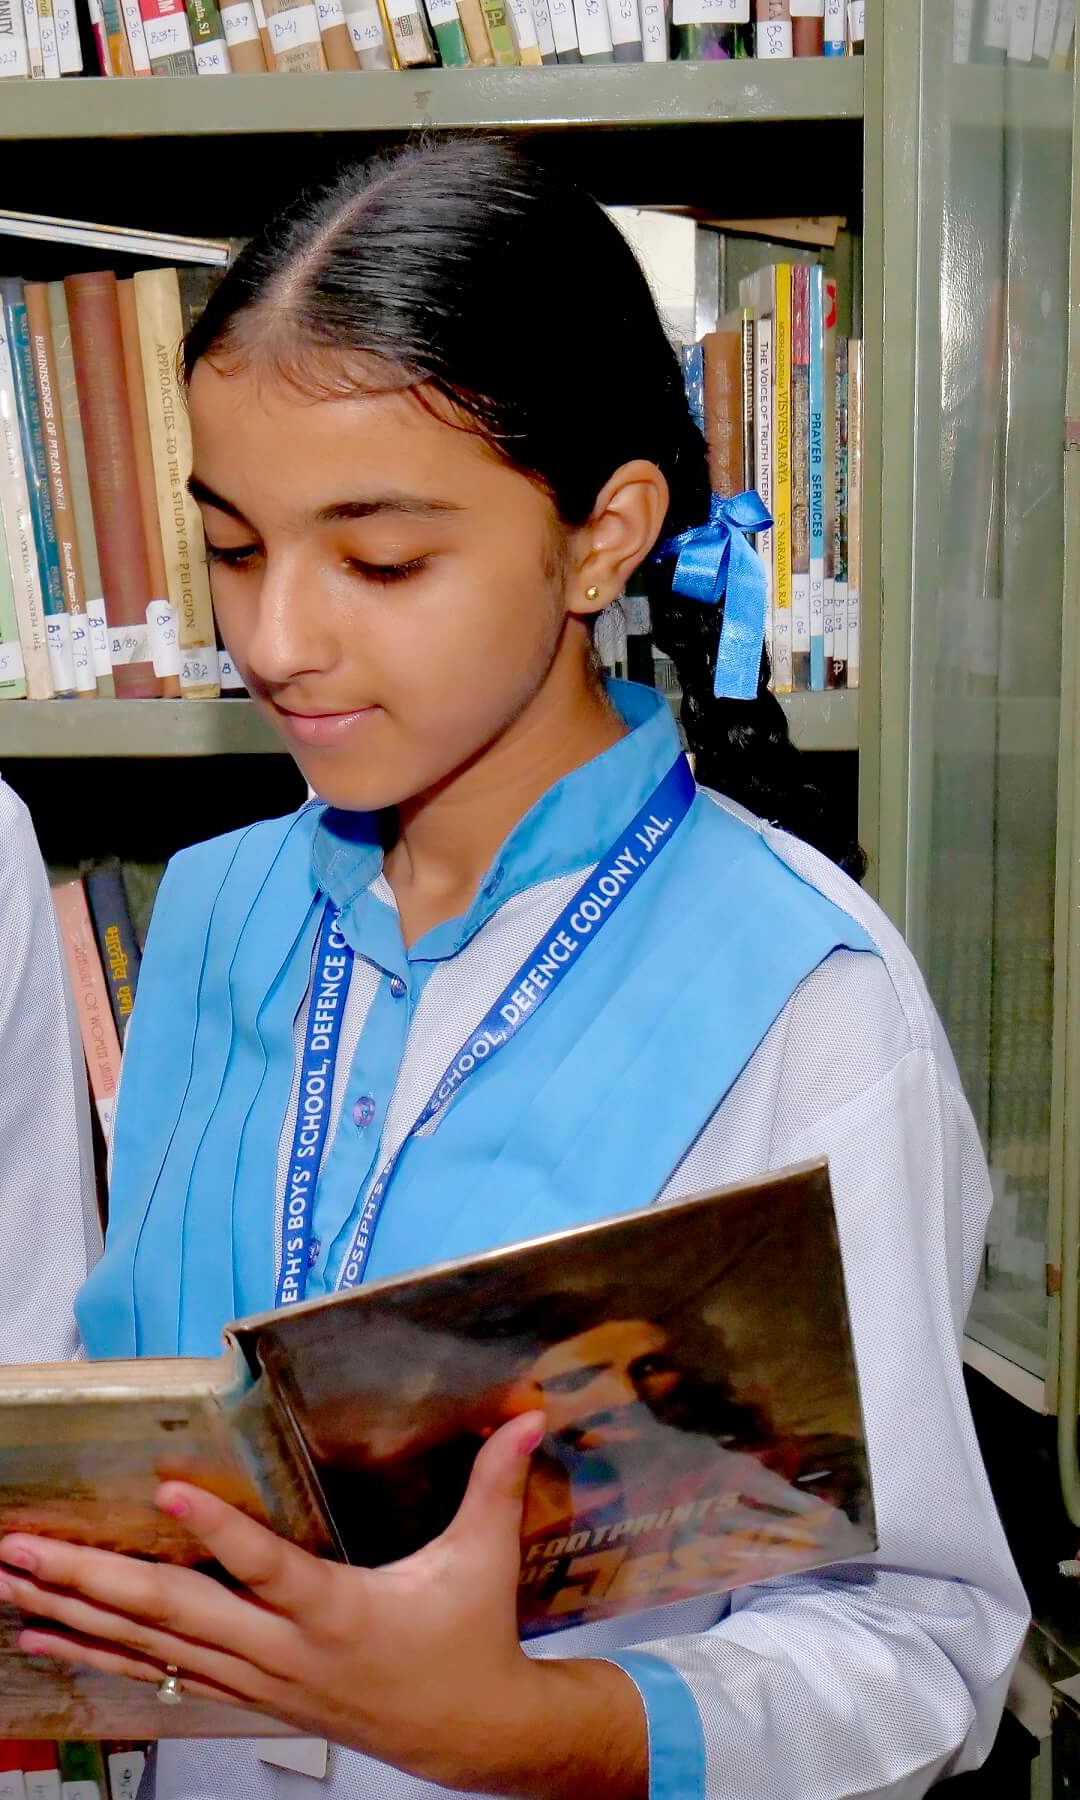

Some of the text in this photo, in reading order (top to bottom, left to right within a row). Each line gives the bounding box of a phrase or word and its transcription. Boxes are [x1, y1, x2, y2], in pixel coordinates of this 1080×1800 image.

[35, 335, 54, 418] REMINISCENCES
[156, 343, 176, 430] APPROACHES
[46, 422, 58, 437] OF
[48, 438, 62, 475] PURAN
[166, 437, 178, 455] TO
[777, 391, 789, 484] VISVESVARAYA
[53, 476, 67, 511] SINGH
[167, 459, 182, 486] THE
[811, 412, 822, 537] PRAYER SERVICES
[171, 491, 188, 535] STUDY
[178, 540, 190, 558] OF
[430, 1028, 506, 1111] SCHOOL,
[501, 935, 578, 1022] DEFENCE
[571, 852, 646, 933] COLONY,
[634, 813, 673, 853] JAL.
[310, 956, 346, 1052] DEFENCE
[297, 1056, 332, 1157] SCHOOL,
[288, 1166, 311, 1230] BOYS'
[281, 1237, 304, 1304] EPH'S
[526, 1493, 741, 1563] FOOTPRINTS
